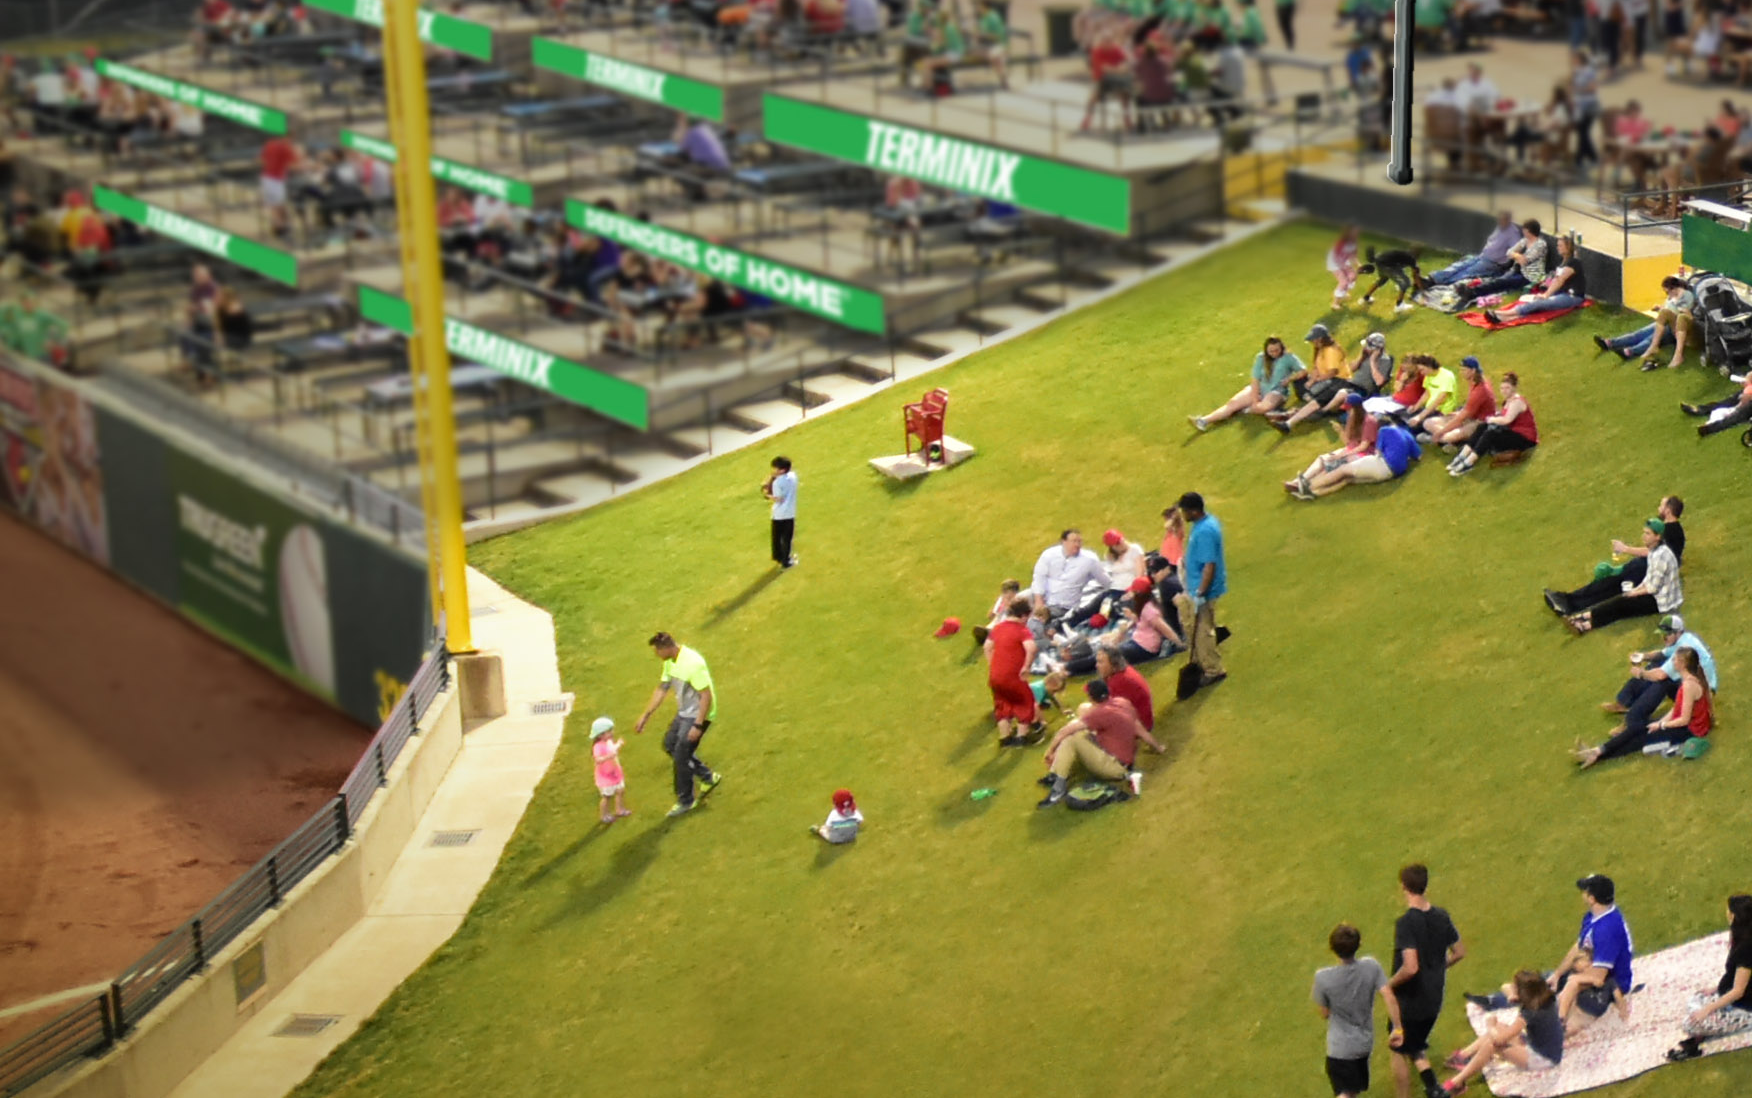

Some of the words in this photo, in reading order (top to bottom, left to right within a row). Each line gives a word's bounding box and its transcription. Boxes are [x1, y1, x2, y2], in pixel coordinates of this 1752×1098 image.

[865, 118, 1023, 201] TERMINIX
[584, 207, 700, 266] DEFENDERS
[705, 247, 740, 278] OF
[746, 259, 845, 318] HOME
[443, 317, 556, 390] ERMINIX
